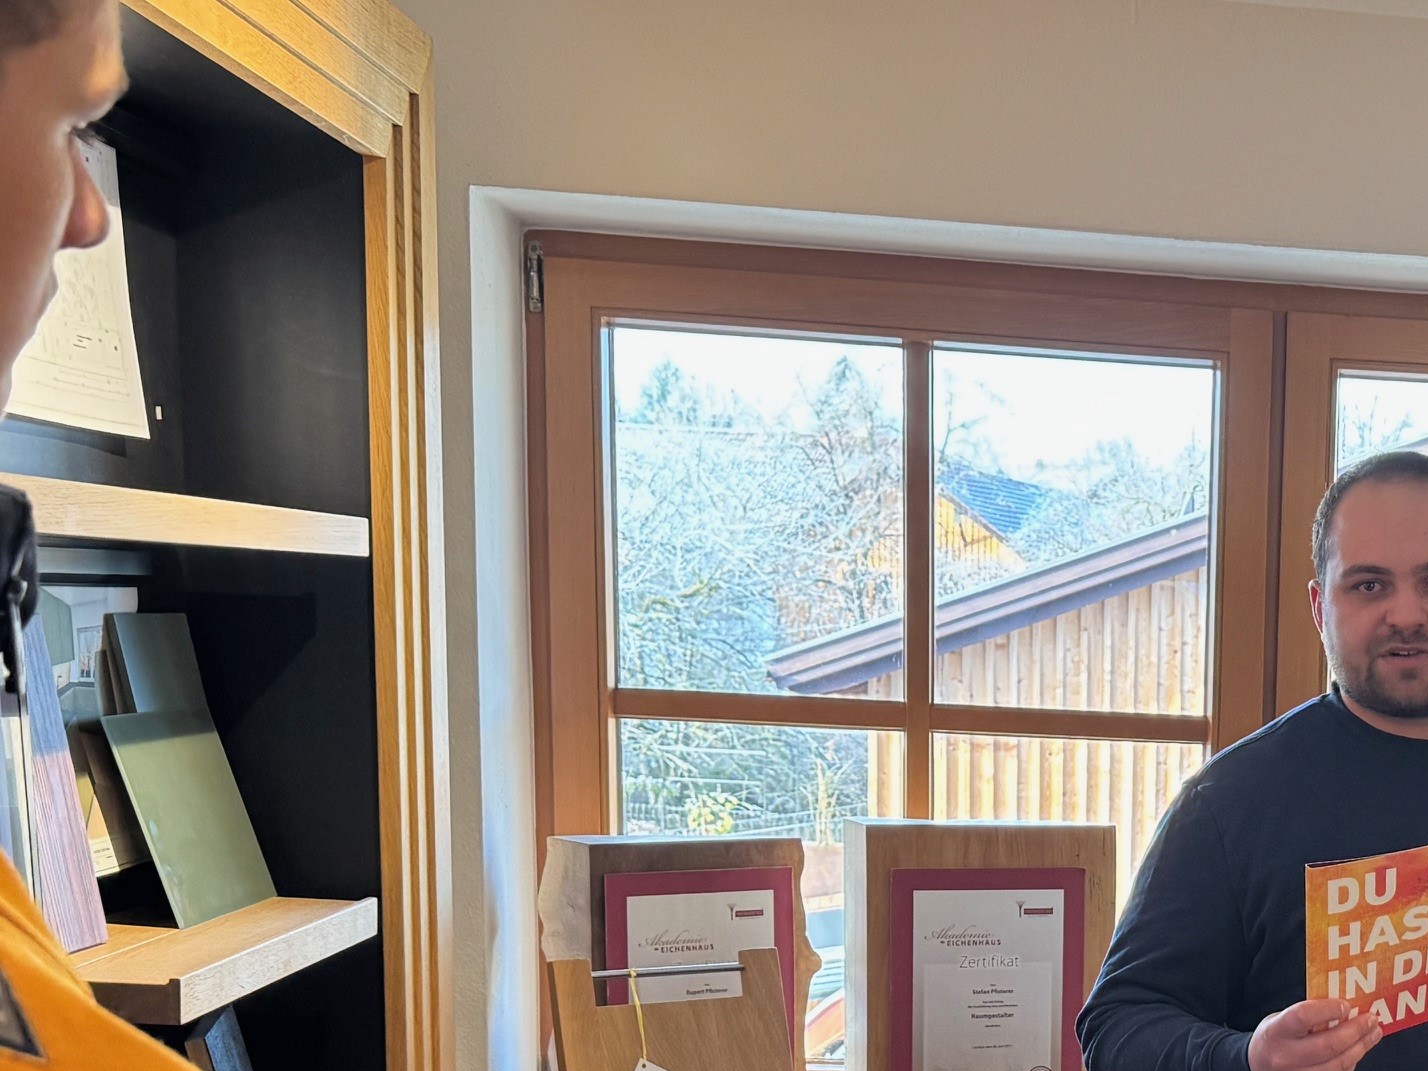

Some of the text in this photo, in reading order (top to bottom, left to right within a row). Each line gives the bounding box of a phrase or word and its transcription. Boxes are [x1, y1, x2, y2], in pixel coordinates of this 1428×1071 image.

[1327, 867, 1397, 915] DU
[661, 943, 714, 953] EICHENHAUS
[947, 939, 1001, 947] EICHENHAUS
[959, 954, 1019, 969] Zertifikat
[1328, 961, 1377, 1000] IN
